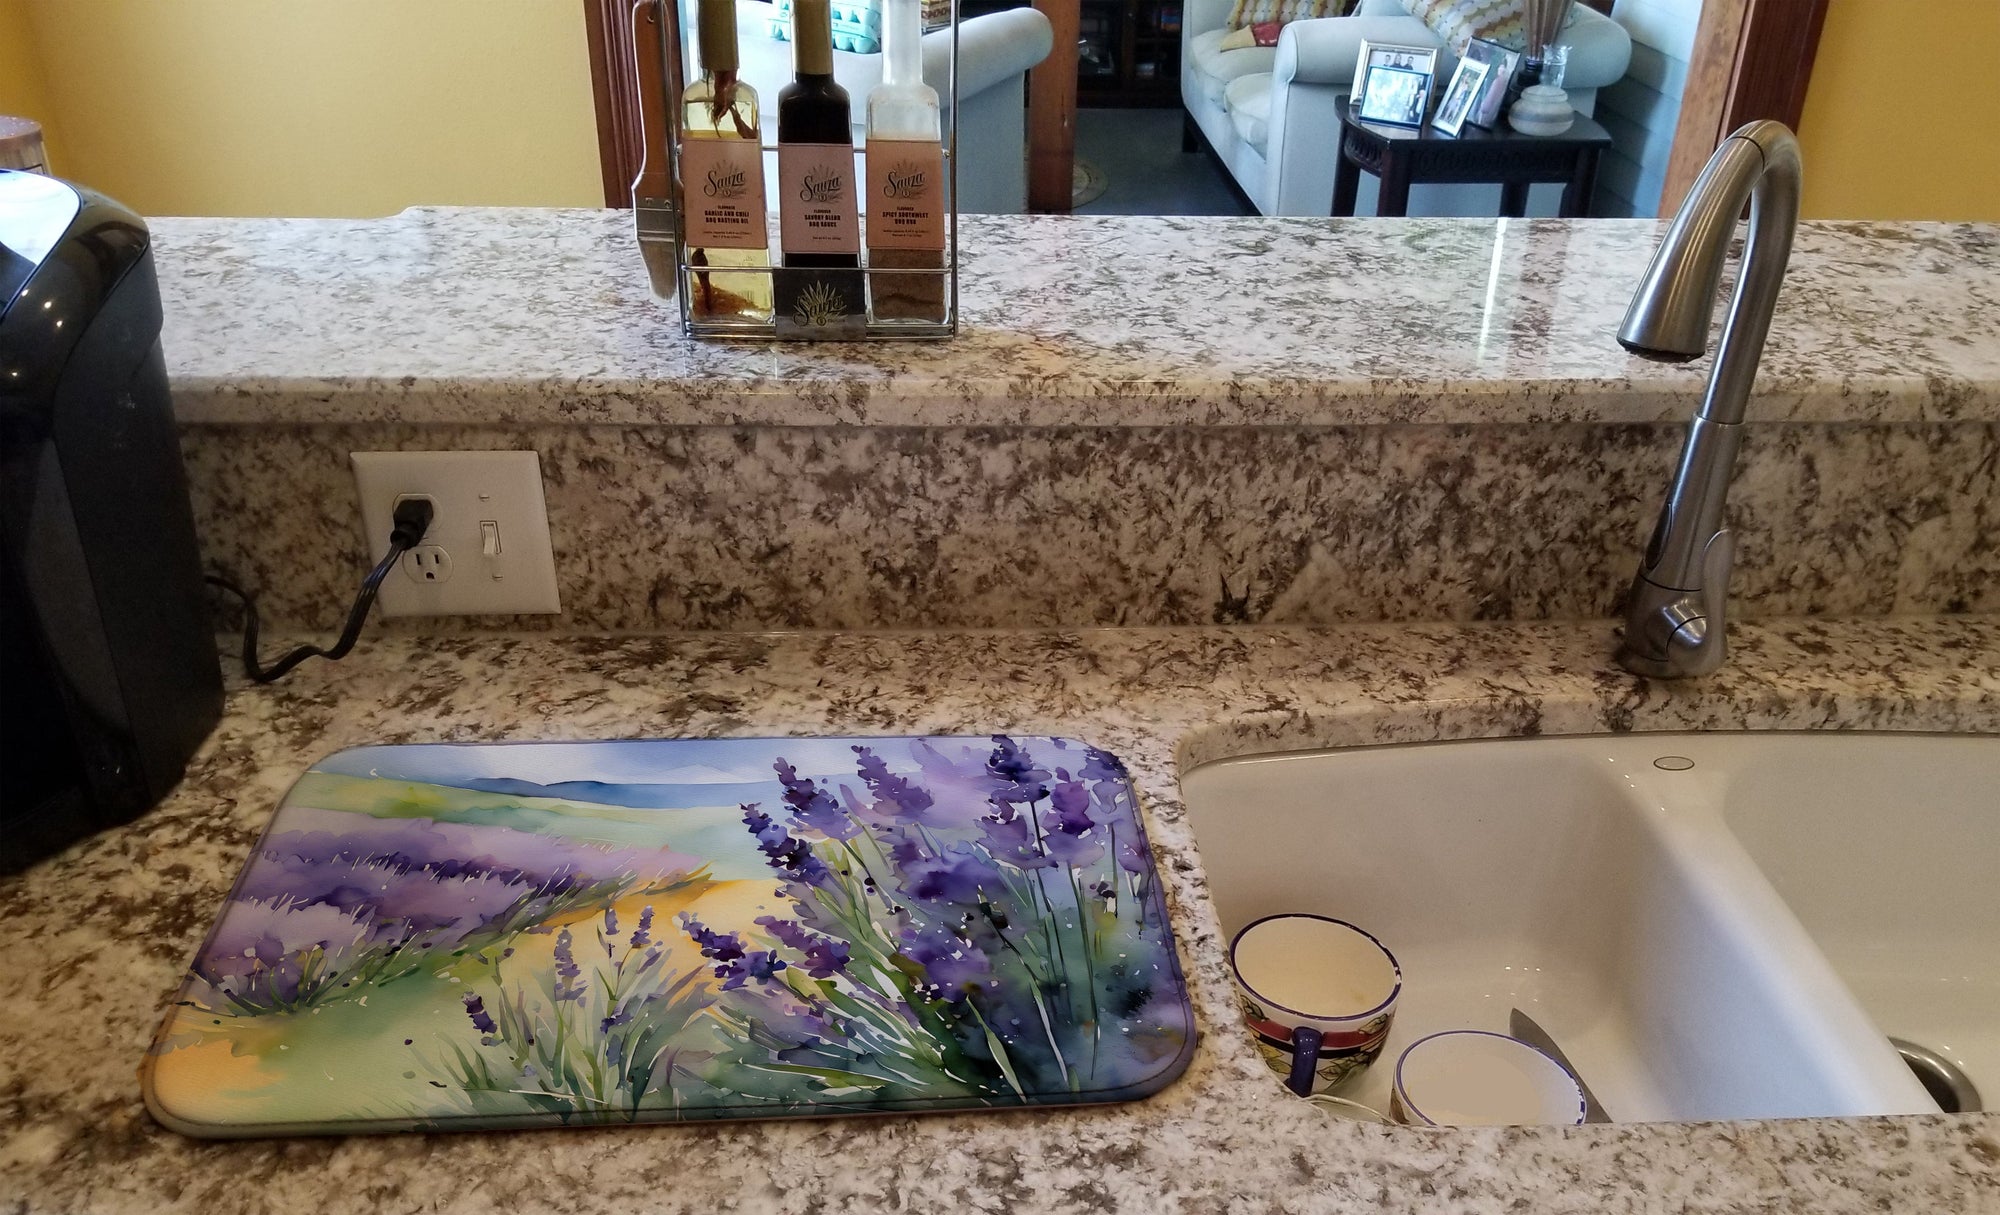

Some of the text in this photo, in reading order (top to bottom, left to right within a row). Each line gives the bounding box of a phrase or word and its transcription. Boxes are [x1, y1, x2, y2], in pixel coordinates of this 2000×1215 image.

[704, 170, 745, 197] Sauza
[800, 175, 841, 202] Sauza
[884, 171, 924, 198] Sauza
